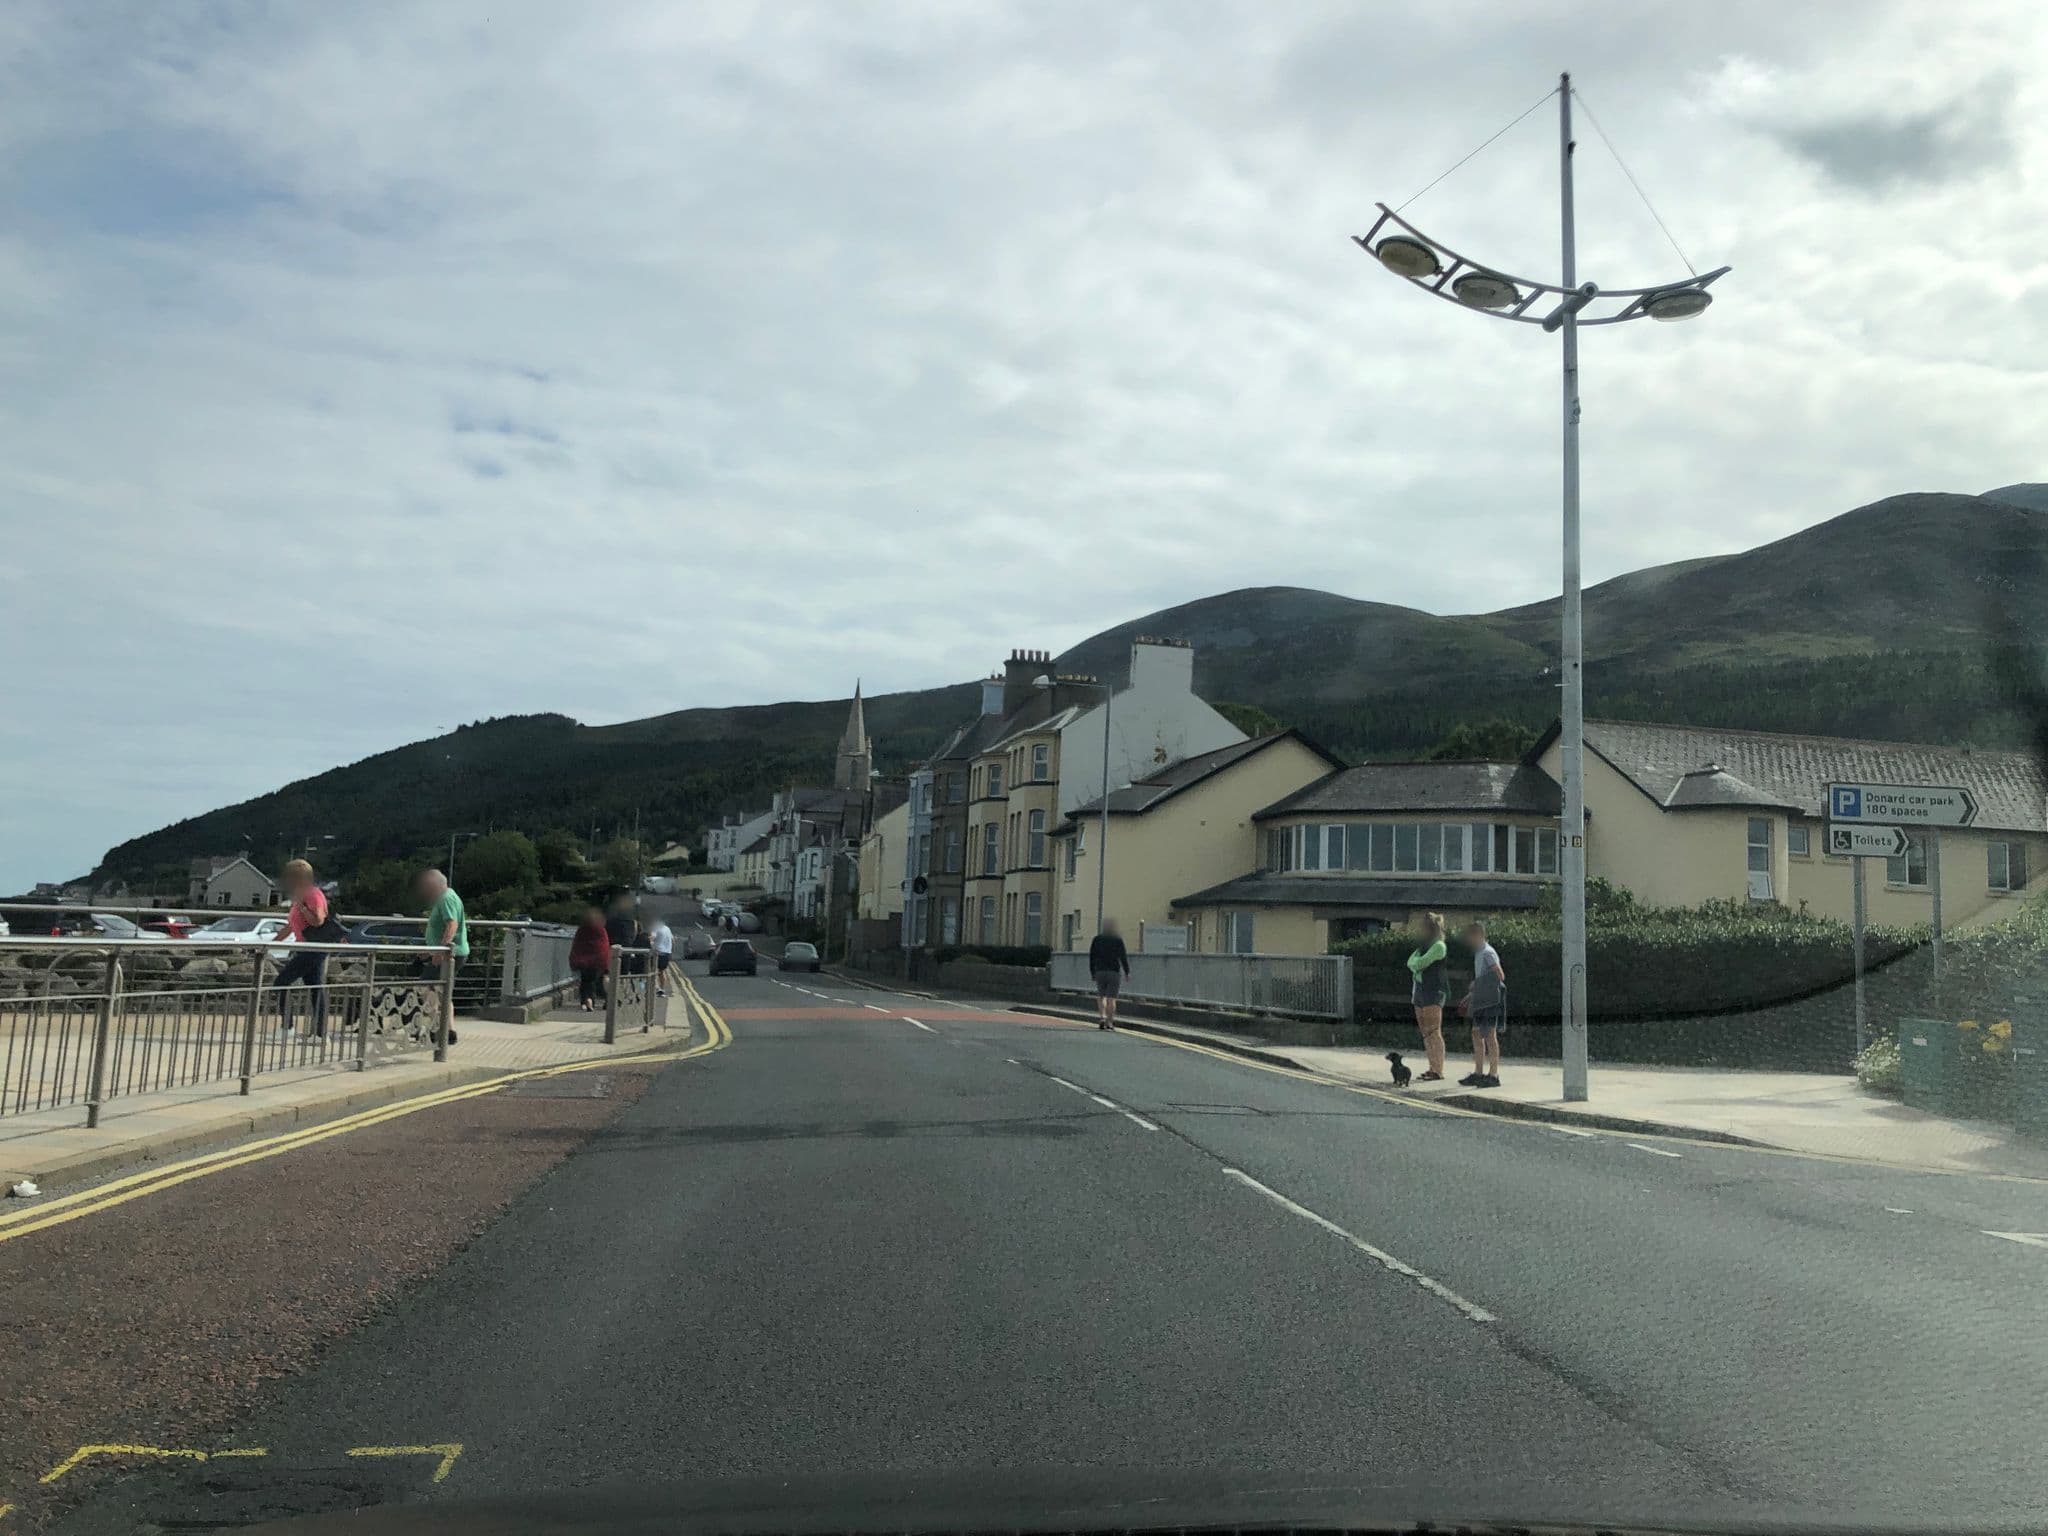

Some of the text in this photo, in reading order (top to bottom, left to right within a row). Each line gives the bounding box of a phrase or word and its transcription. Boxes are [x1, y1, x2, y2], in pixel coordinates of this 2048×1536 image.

[1839, 790, 1856, 814] P
[1865, 792, 1954, 807] Donard car park
[1866, 804, 1929, 817] 180 spaces
[1854, 834, 1893, 846] Toilets
